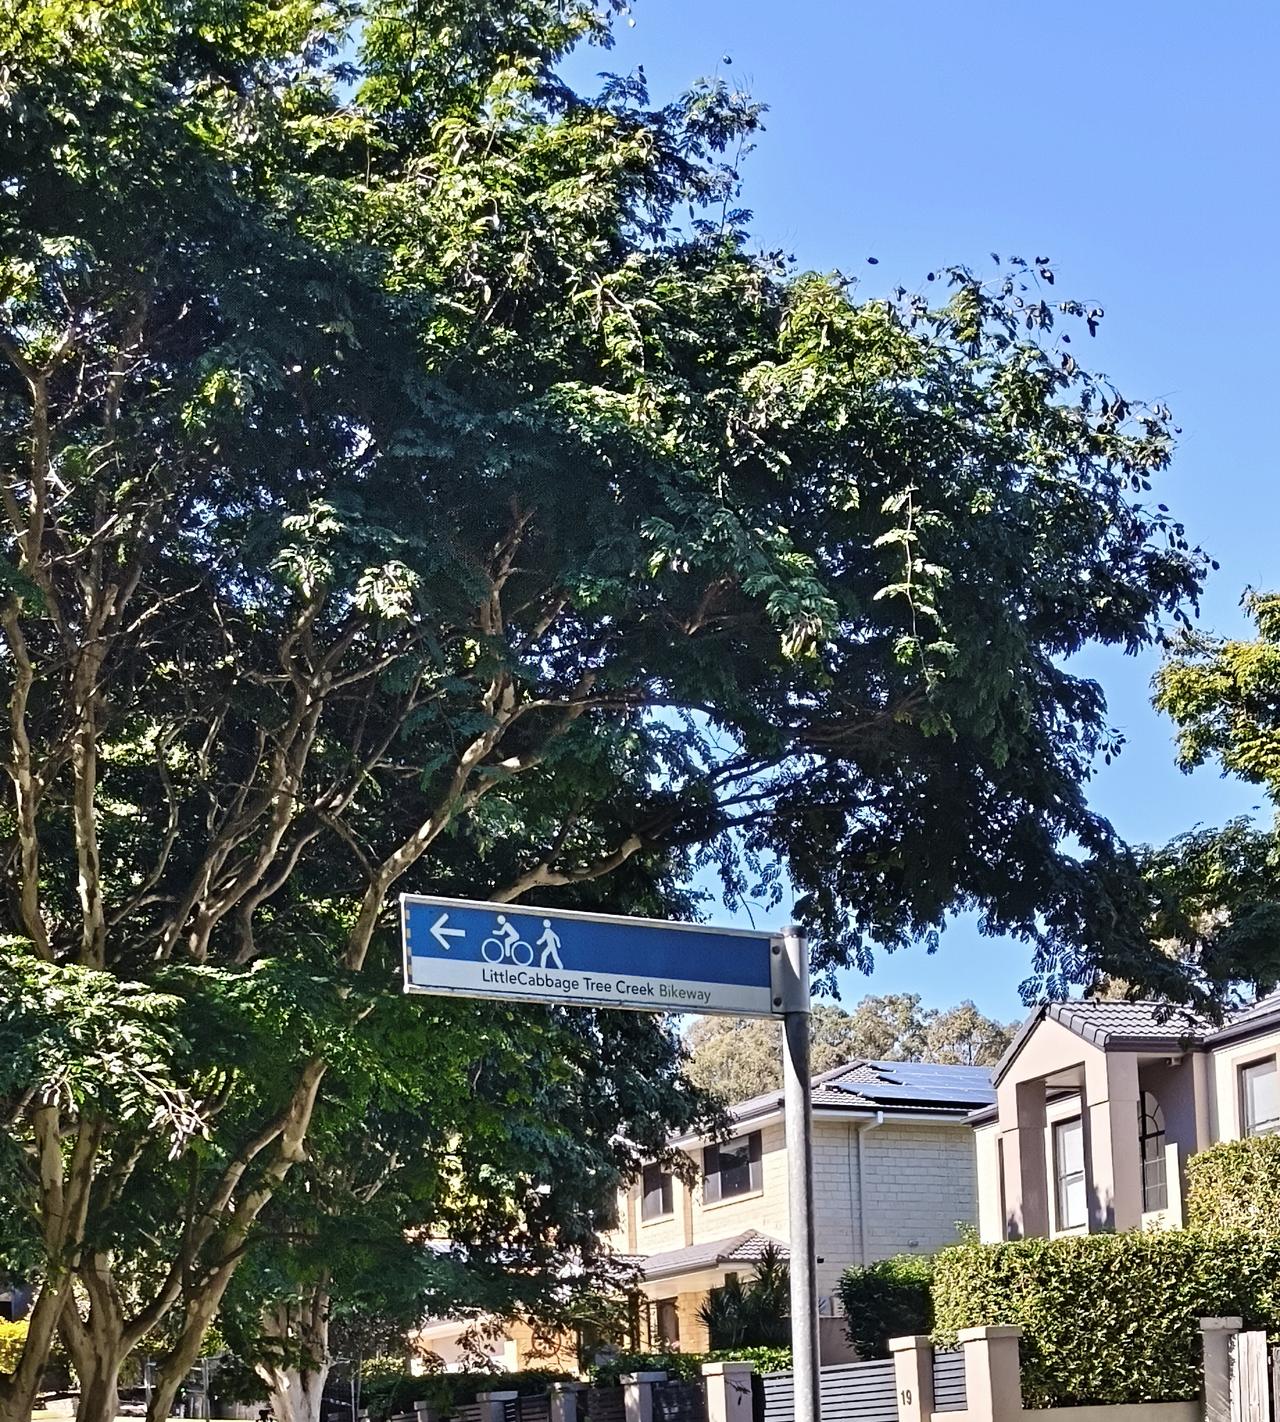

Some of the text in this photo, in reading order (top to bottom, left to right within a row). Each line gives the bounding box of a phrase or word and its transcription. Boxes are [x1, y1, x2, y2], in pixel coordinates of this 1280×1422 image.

[583, 977, 612, 993] Tree
[616, 980, 655, 996] Creek
[659, 984, 711, 1004] Bikeway
[901, 1389, 912, 1405] 19
